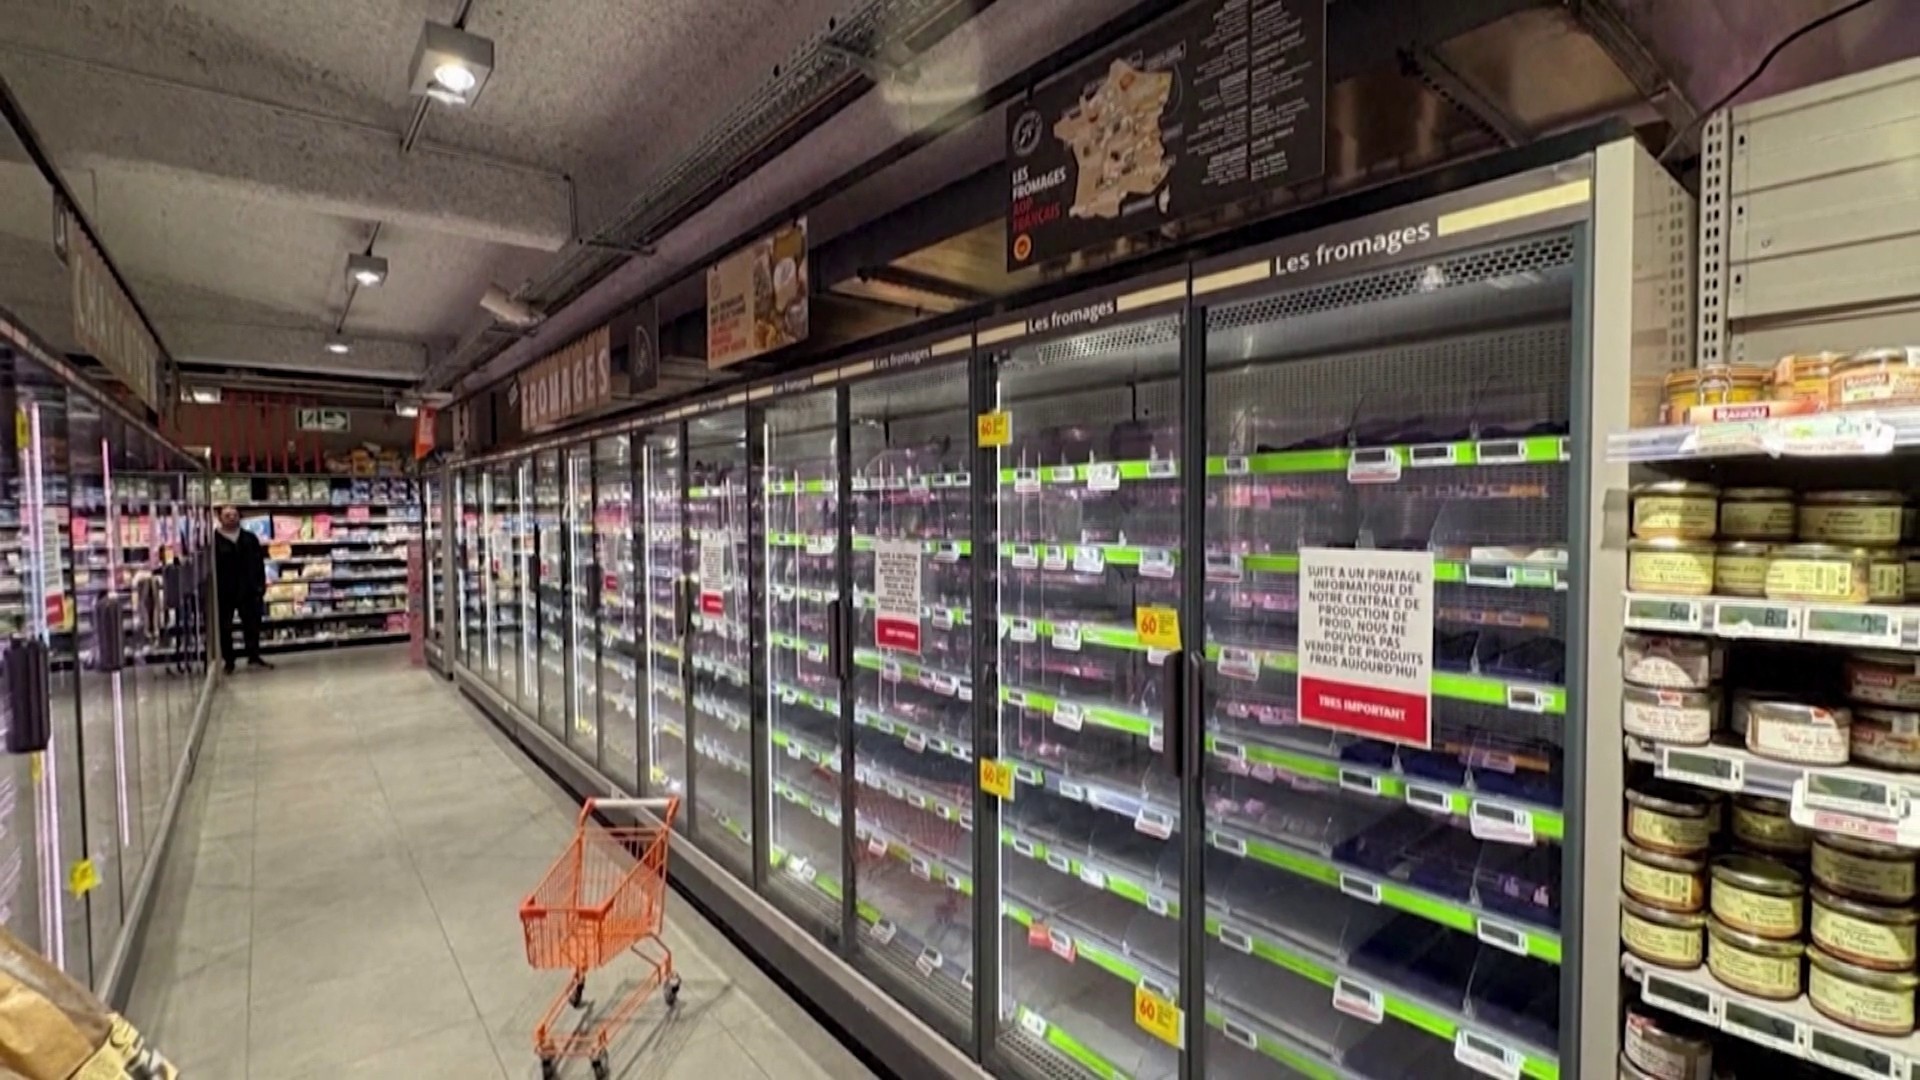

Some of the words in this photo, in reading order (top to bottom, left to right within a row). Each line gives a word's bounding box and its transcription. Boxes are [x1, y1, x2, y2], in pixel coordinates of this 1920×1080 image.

[1012, 164, 1028, 186] LES
[1012, 165, 1066, 202] FROMAGES
[1275, 250, 1309, 276] Les
[1316, 219, 1431, 266] fromages
[1028, 317, 1048, 333] Les
[1051, 301, 1114, 327] fromages
[521, 348, 610, 431] FROMAGES
[1308, 565, 1335, 577] SUITE
[1338, 566, 1345, 578] A
[1348, 568, 1365, 579] UN
[1367, 568, 1422, 583] PIRATAGE
[1313, 579, 1395, 595] INFORMATIQUE
[1399, 583, 1413, 596] DE
[1308, 590, 1342, 603] NOTRE
[1346, 593, 1401, 608] CENTRALE
[1404, 598, 1419, 610] DE
[1318, 604, 1389, 620] PRODUCTION
[1393, 610, 1407, 622] DE
[1141, 614, 1157, 635] 60
[1357, 620, 1388, 634] NOUS
[1391, 624, 1406, 636] NE
[1324, 630, 1376, 646] POUVONS
[1379, 636, 1400, 649] PAS
[1304, 640, 1344, 655] VENDRE
[1348, 645, 1361, 657] DE
[1366, 648, 1424, 666] PRODUITS
[1310, 653, 1338, 667] FRAIS
[1340, 657, 1417, 679] AUJOURD'HUI
[1344, 699, 1406, 721] IMPORTANT
[1139, 998, 1155, 1021] 60
